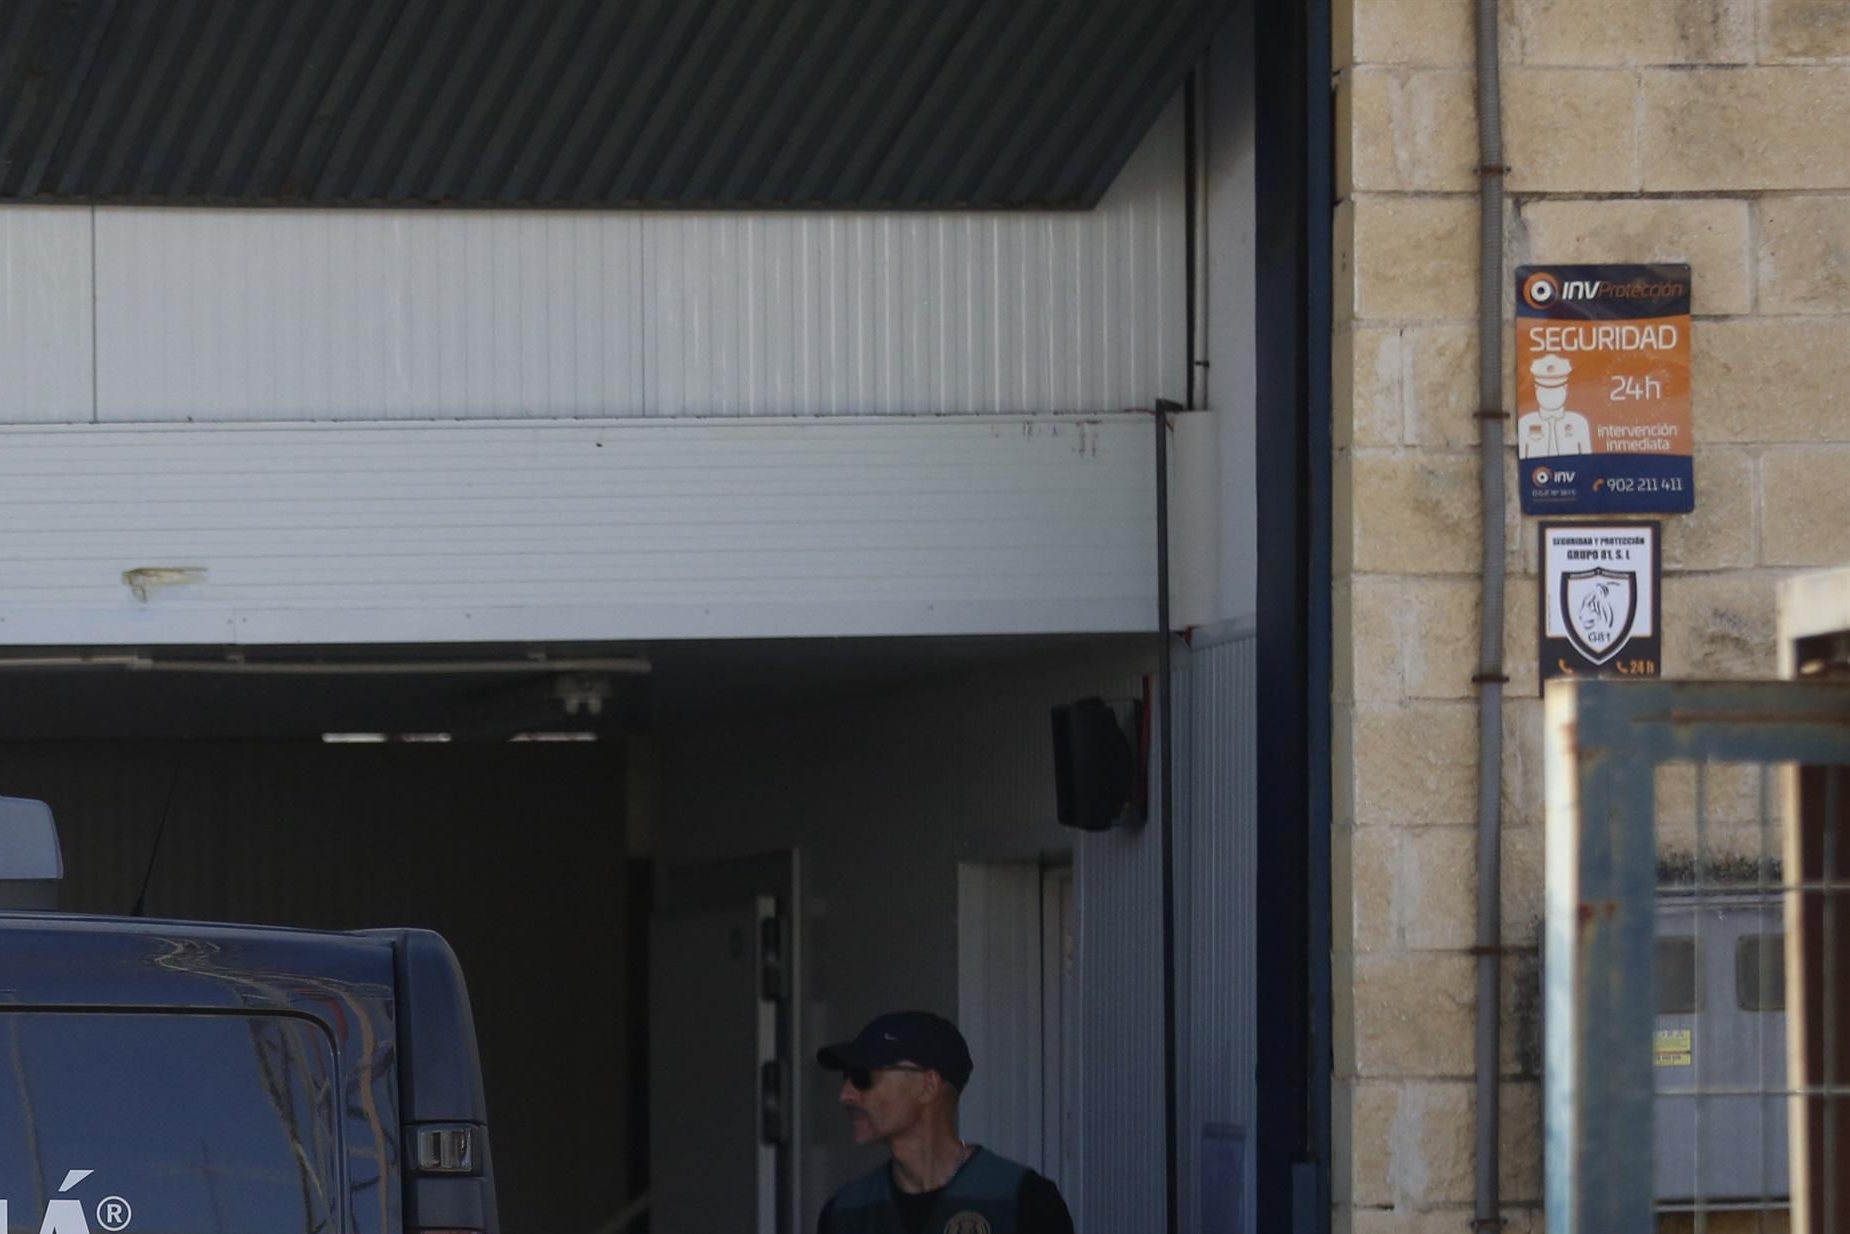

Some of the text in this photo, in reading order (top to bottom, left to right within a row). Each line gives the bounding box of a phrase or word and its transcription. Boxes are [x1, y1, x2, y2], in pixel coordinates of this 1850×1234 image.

[1528, 324, 1677, 352] SEGURIDAD
[1597, 423, 1678, 437] intervención
[1606, 437, 1671, 451] inmediata
[1606, 477, 1683, 492] 902 211 411
[1567, 549, 1599, 561] GRUPO
